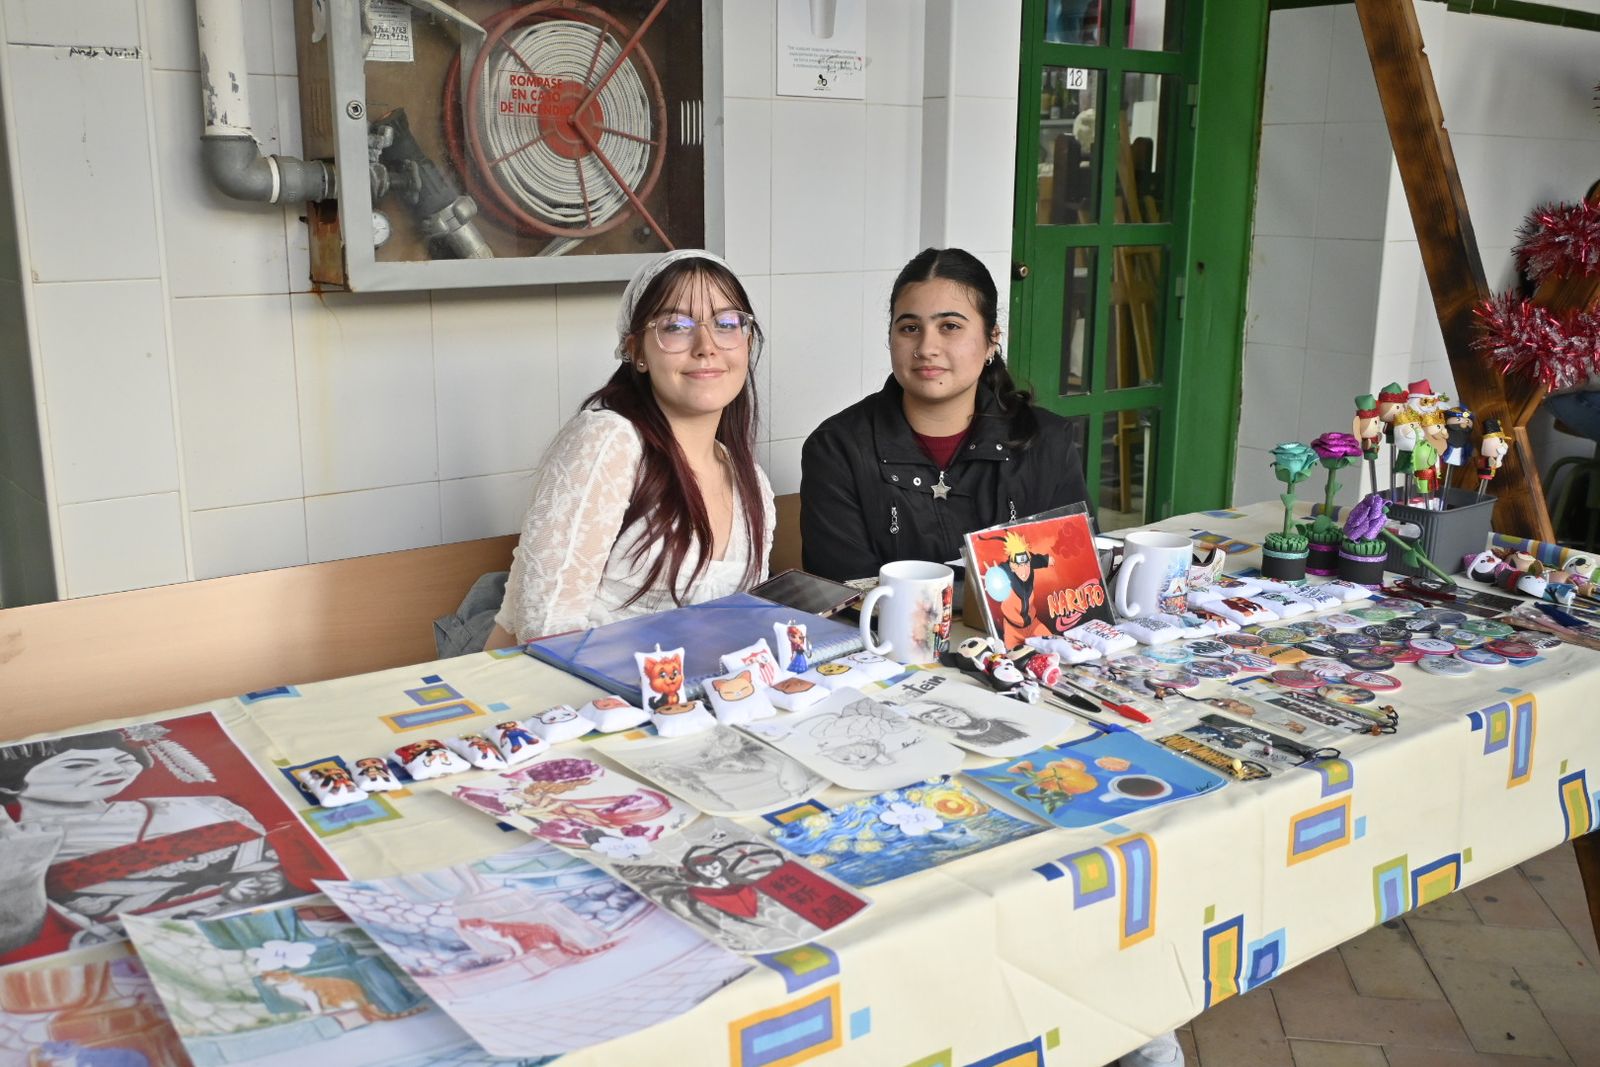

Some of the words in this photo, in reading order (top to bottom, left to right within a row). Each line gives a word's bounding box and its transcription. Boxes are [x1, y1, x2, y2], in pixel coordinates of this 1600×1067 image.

[509, 75, 563, 89] ROMPASE
[1069, 69, 1083, 87] 18
[511, 88, 527, 100] EN
[530, 89, 561, 102] CASO
[500, 101, 514, 113] DE
[518, 102, 571, 116] INCENDIO
[1047, 584, 1105, 619] NARUTO
